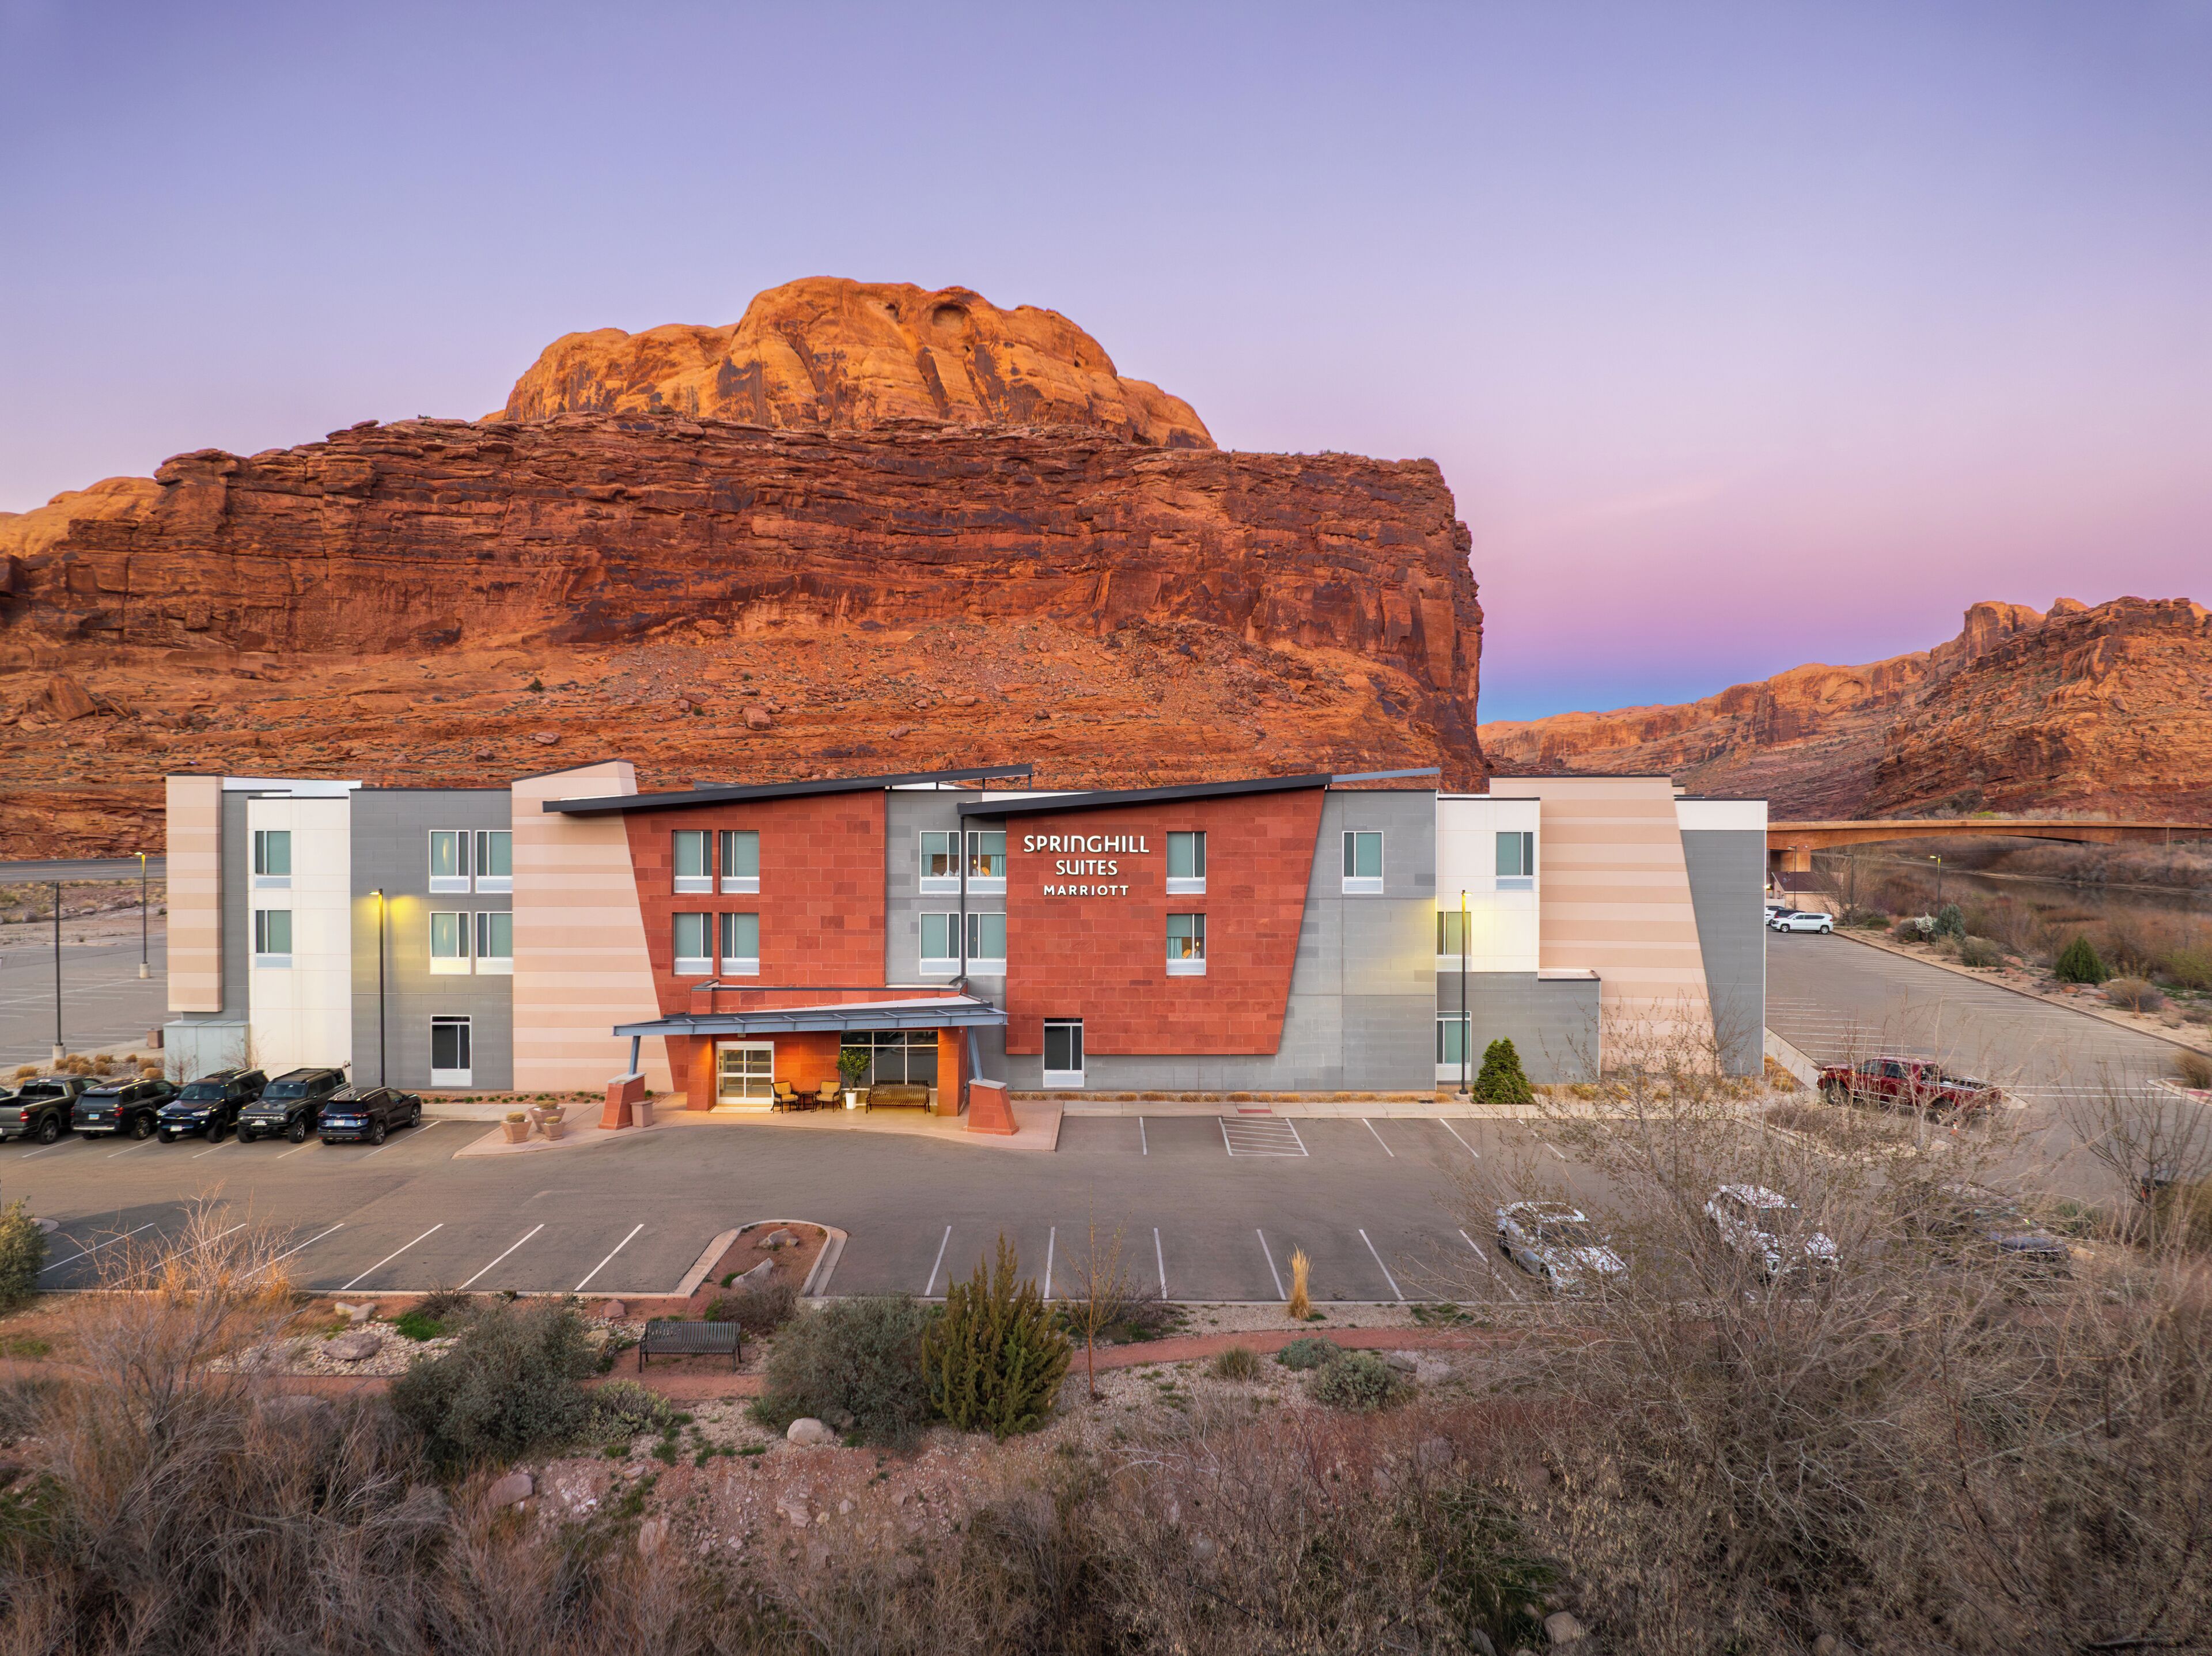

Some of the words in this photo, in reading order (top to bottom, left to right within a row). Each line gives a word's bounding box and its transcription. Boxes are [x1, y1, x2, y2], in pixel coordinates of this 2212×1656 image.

[1024, 835, 1150, 853] SPRINGHILL
[1055, 860, 1118, 876] SUITES
[1044, 885, 1129, 896] MARRIOTT
